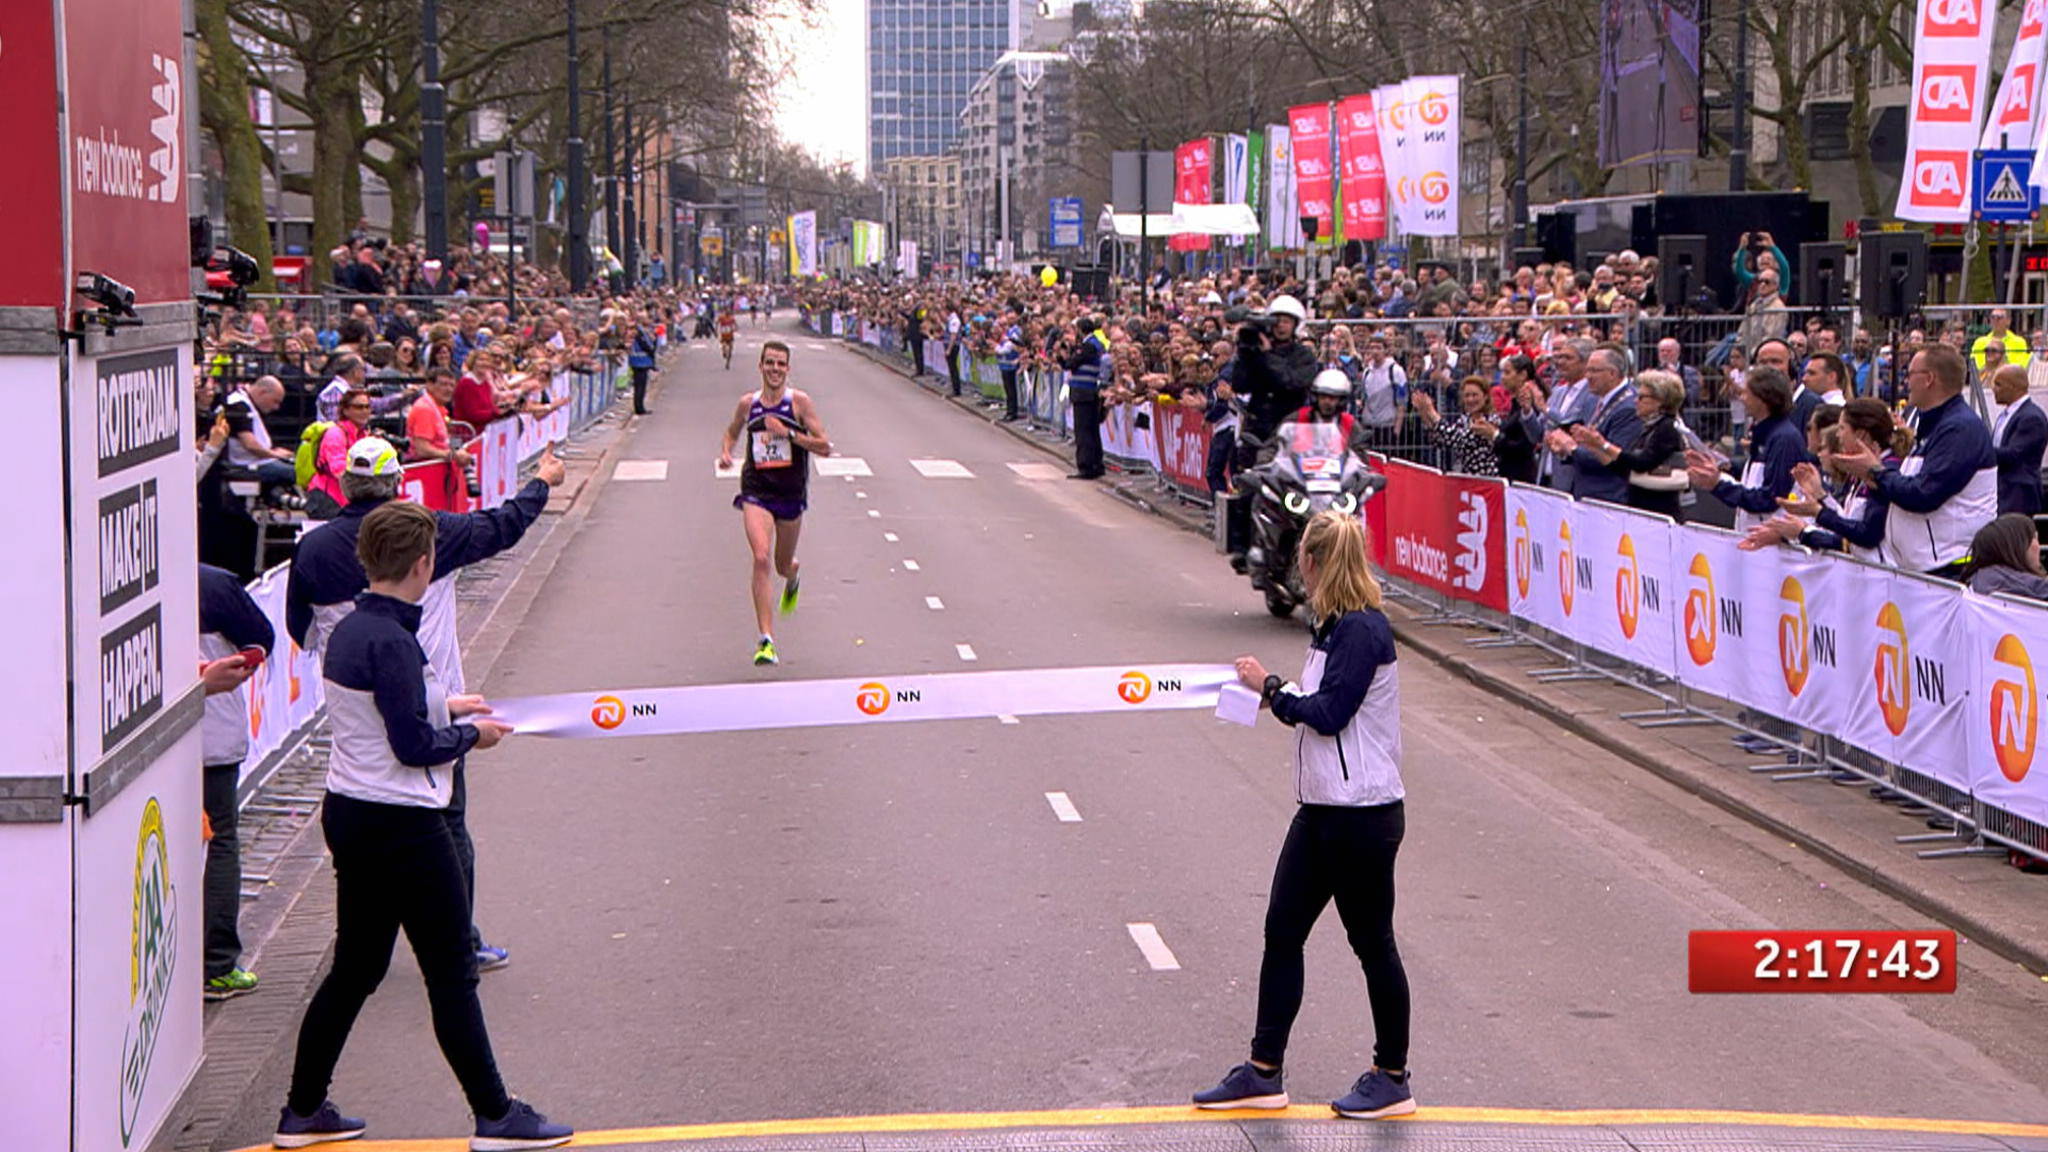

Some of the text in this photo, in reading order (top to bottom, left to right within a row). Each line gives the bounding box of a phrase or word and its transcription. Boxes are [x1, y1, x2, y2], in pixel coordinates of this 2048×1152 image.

[77, 125, 143, 199] new balance
[99, 364, 179, 460] ROTTERDAM.
[101, 495, 156, 598] MAKE IT
[1395, 532, 1448, 583] new balance
[1576, 555, 1592, 591] NN
[1641, 574, 1660, 613] NN
[1720, 597, 1742, 638] NN
[1813, 624, 1836, 669] NN
[103, 622, 161, 737] HAPPEN.
[896, 690, 921, 702] NN
[1157, 679, 1182, 692] NN
[1915, 655, 1946, 707] NN
[632, 703, 657, 717] NN
